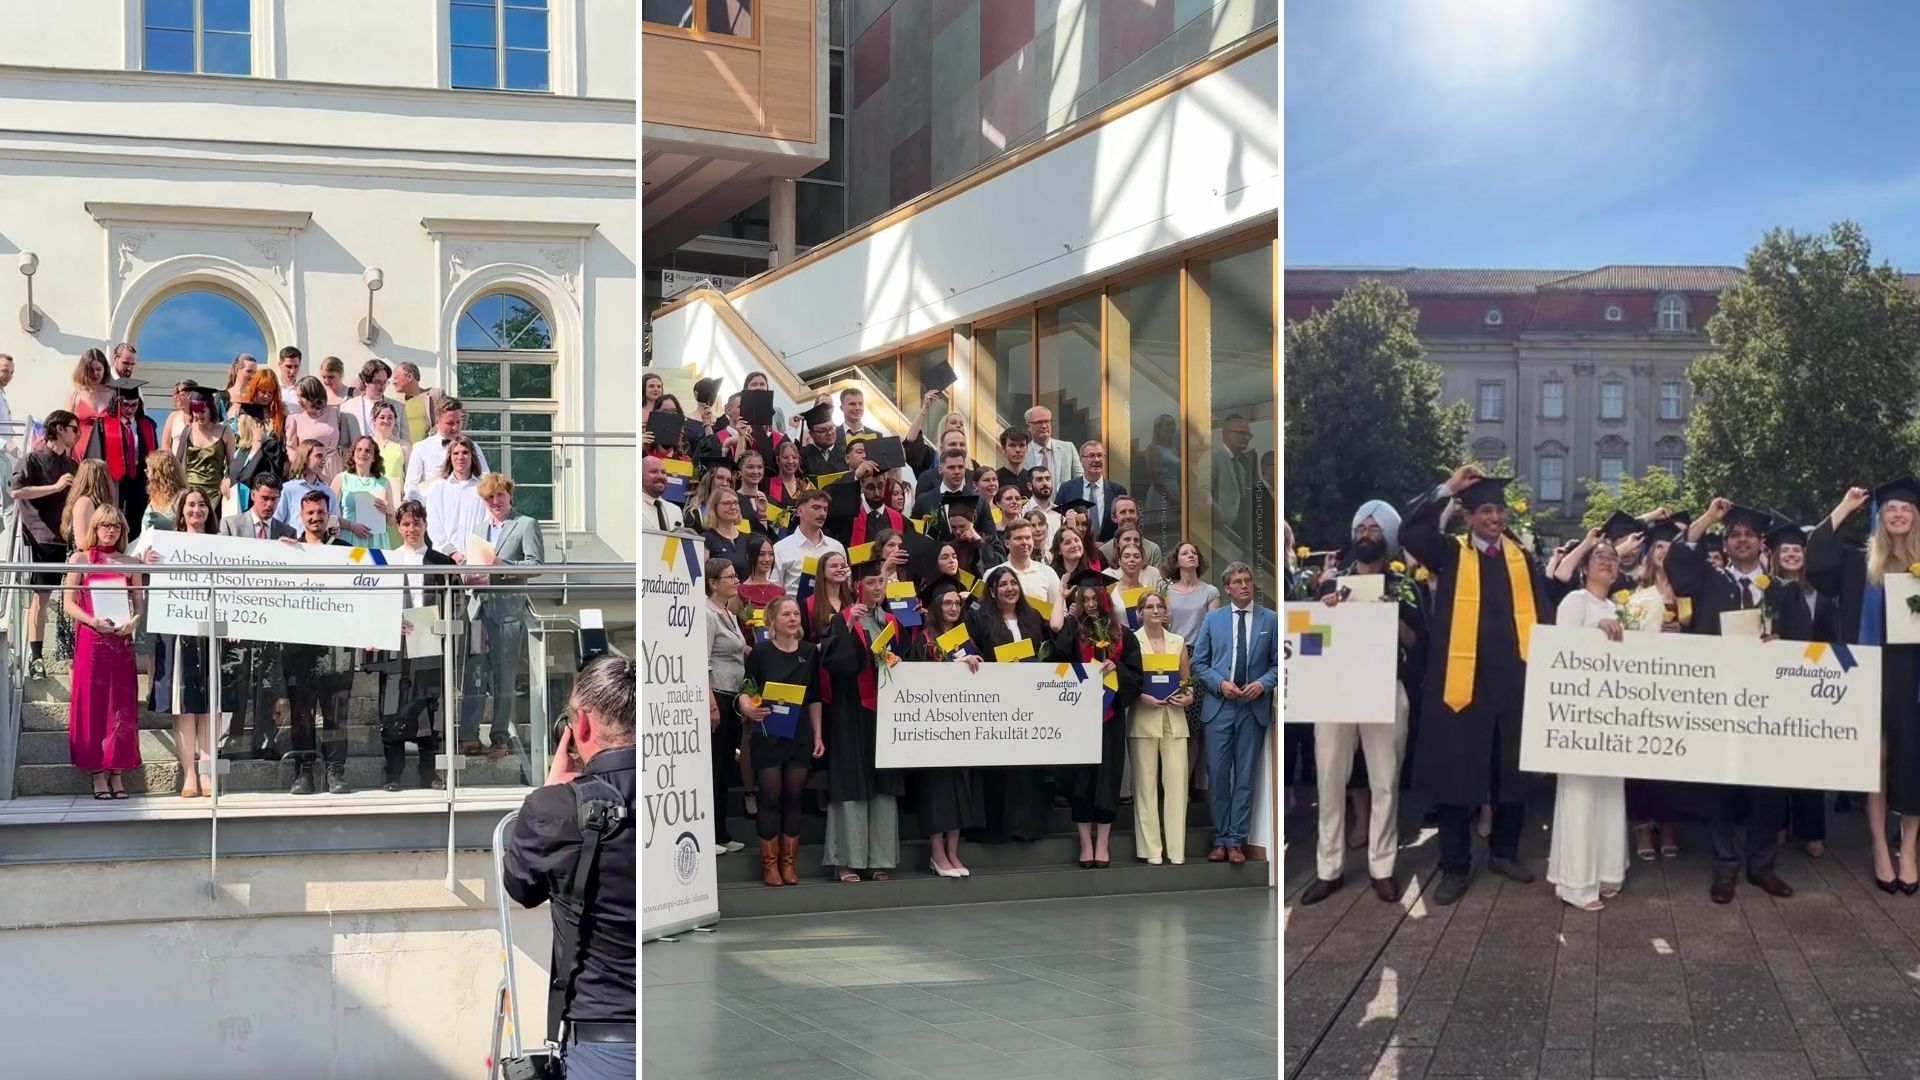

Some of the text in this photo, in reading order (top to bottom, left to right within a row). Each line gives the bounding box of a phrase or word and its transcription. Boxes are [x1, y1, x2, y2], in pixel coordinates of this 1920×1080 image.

[665, 273, 673, 282] 2
[714, 279, 722, 287] 3
[642, 574, 690, 599] graduation
[167, 588, 355, 614] Kultuwissenschaftlichen
[166, 603, 268, 625] Fakulät 2026
[668, 595, 696, 638] day
[642, 640, 686, 685] You
[1550, 651, 1717, 679] Absolventinnen
[1775, 665, 1841, 680] graduation
[667, 686, 694, 704] made
[893, 689, 1001, 704] Absolventinnen
[1036, 679, 1078, 690] graduation
[1058, 688, 1082, 706] day
[1550, 679, 1769, 709] und Absolventen der
[1810, 678, 1848, 706] day
[648, 702, 693, 727] We are
[893, 708, 1034, 723] und Absolventen der
[1547, 702, 1859, 741] Wirtschaftswissenschaftlichen
[642, 717, 701, 771] proud
[892, 726, 1062, 745] Juristischen Fakultät 2026
[1545, 729, 1688, 758] Fakultät 2026
[656, 750, 677, 790] of
[644, 788, 706, 848] you.
